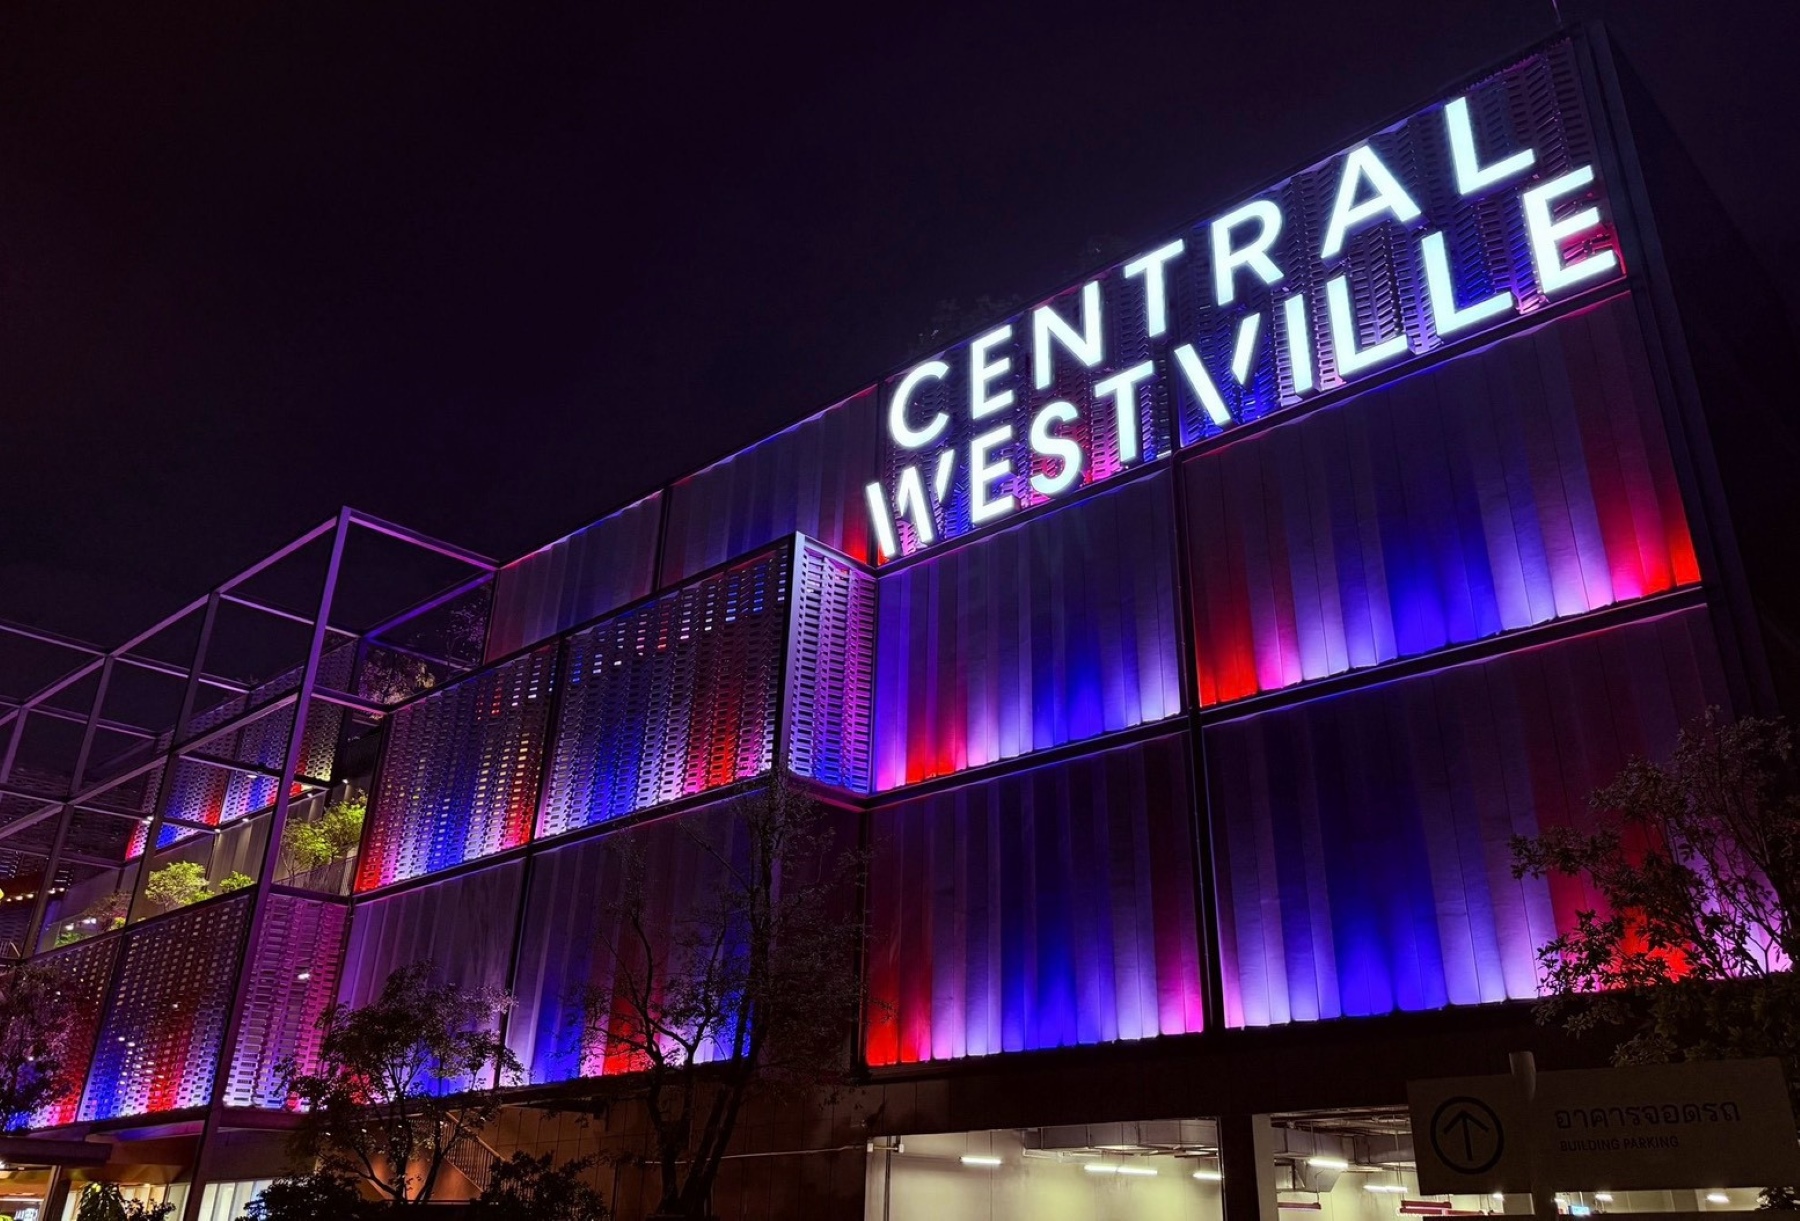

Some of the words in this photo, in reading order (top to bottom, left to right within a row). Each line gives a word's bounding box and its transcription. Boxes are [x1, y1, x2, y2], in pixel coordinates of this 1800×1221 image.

[866, 163, 1617, 559] WESTVILLE
[888, 97, 1534, 450] CENTRAL
[1556, 1101, 1741, 1129] อาคารจอดรถ
[1560, 1138, 1621, 1152] BUILDING
[1623, 1136, 1679, 1151] PARKING
